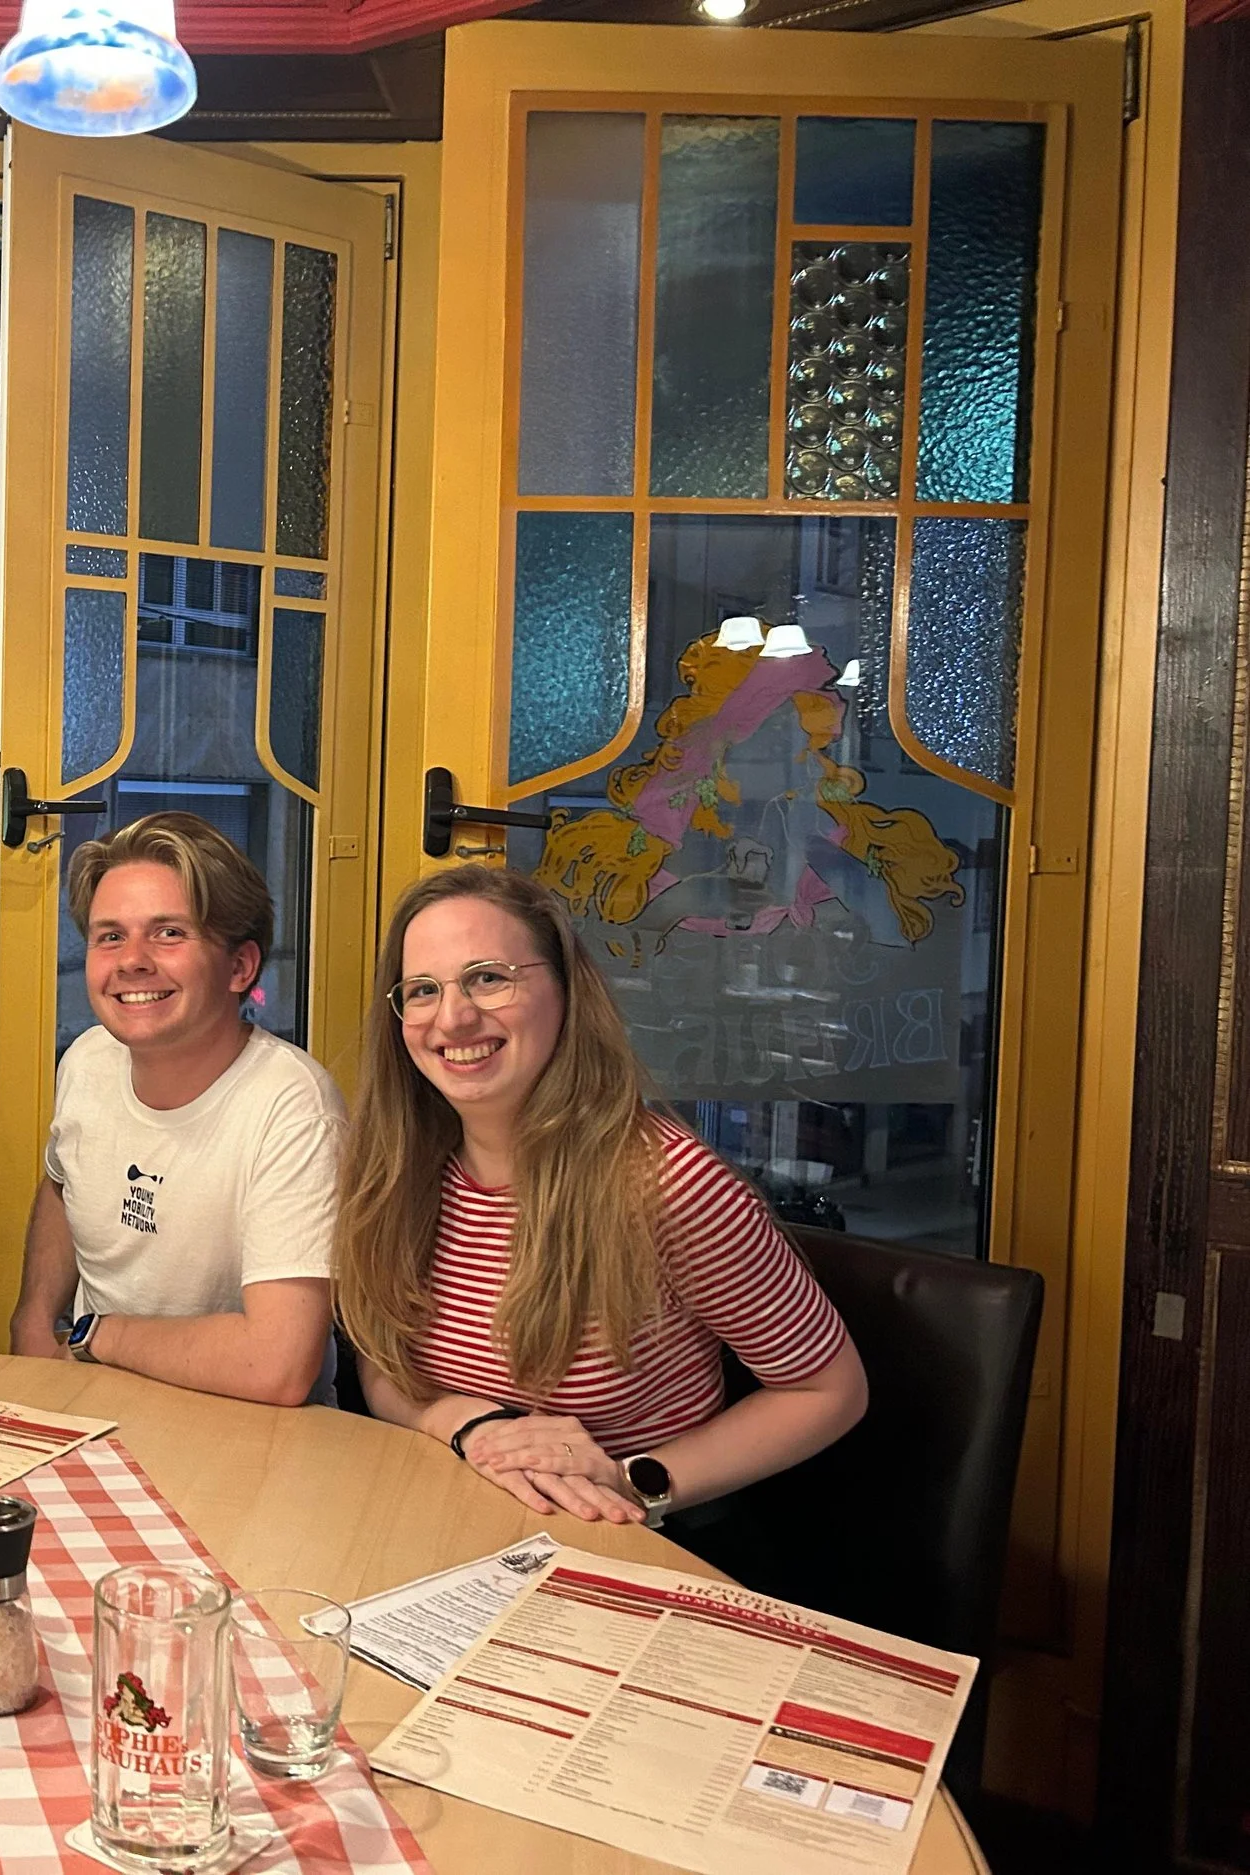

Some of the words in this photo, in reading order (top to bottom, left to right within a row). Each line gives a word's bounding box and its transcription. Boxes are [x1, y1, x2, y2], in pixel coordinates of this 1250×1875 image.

[130, 1186, 154, 1205] YOUNG
[123, 1198, 155, 1220] MOBILITY
[121, 1211, 158, 1234] NETWORK
